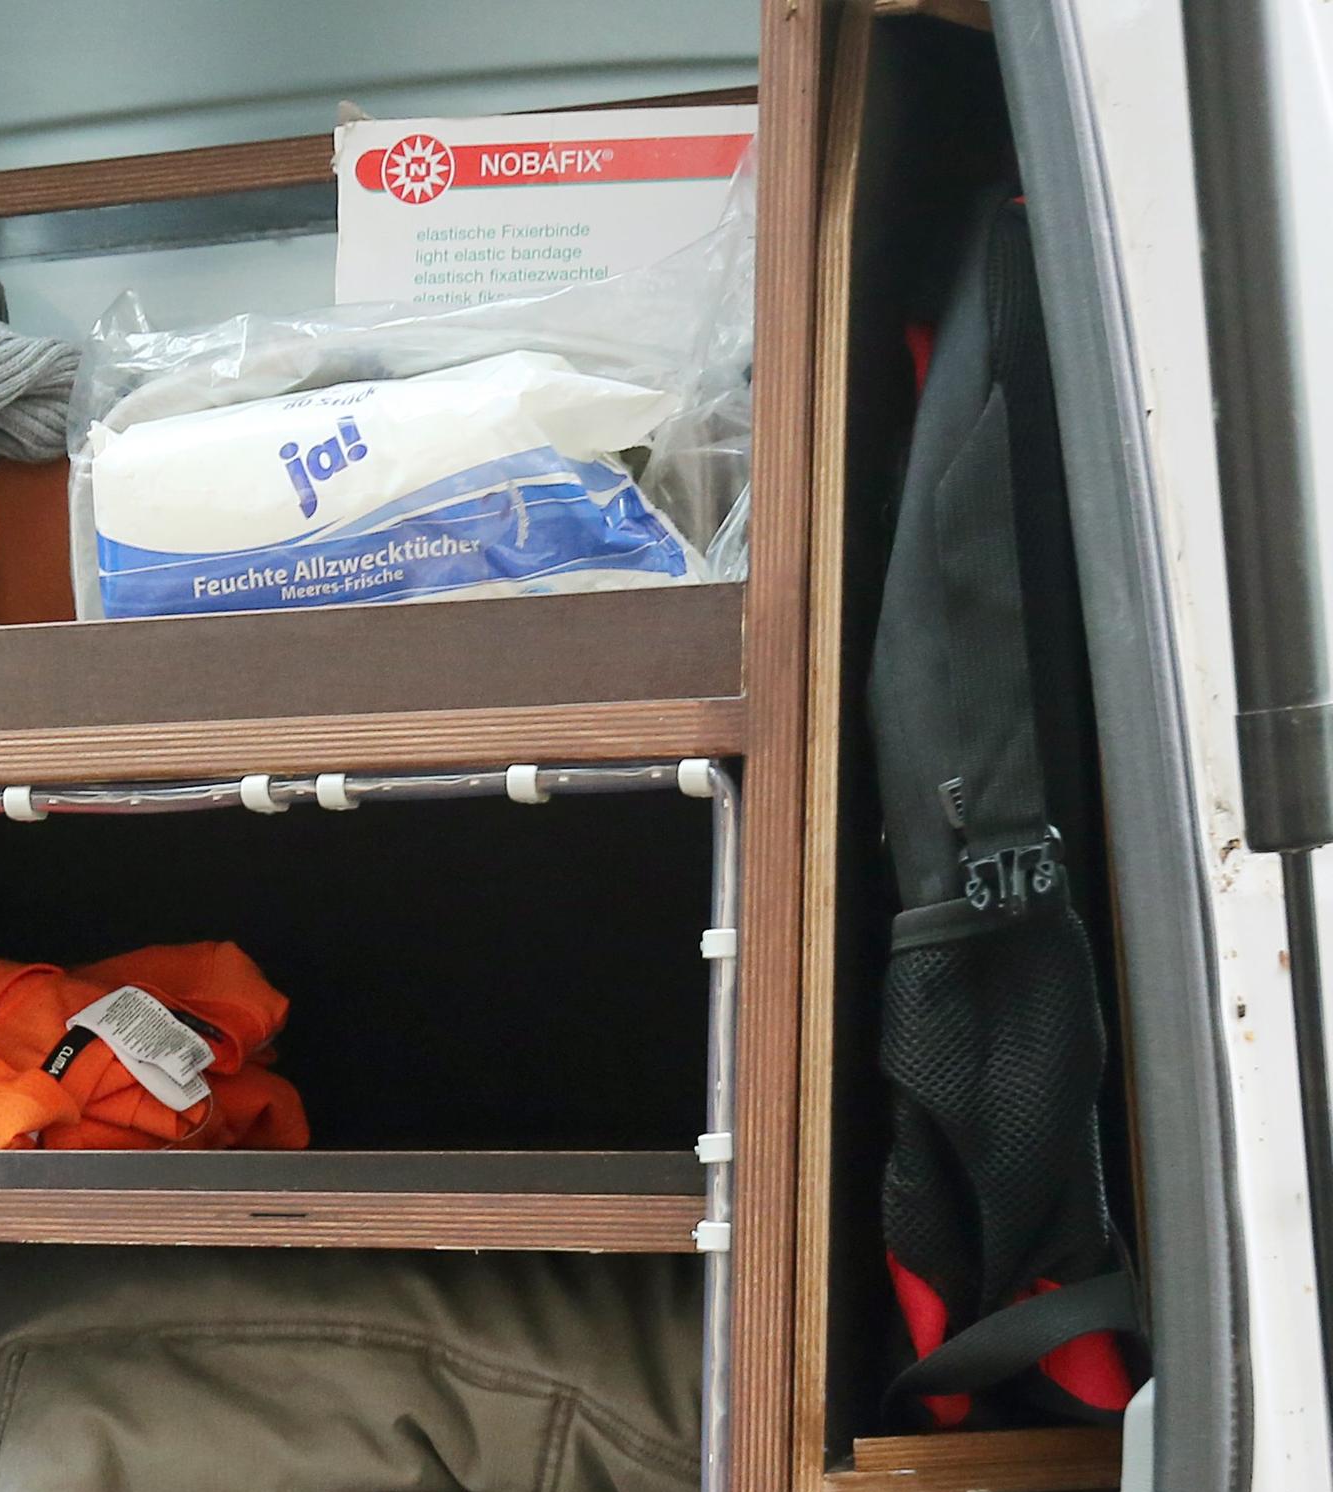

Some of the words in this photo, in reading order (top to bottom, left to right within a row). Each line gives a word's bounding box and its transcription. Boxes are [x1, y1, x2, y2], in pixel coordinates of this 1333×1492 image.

[416, 226, 496, 242] elastische
[501, 223, 590, 240] Fixierbinde
[415, 248, 448, 266] light
[454, 247, 505, 262] elastic
[511, 246, 582, 262] bandage
[414, 269, 483, 285] elastisch
[489, 266, 609, 282] fixatiezwachtel
[278, 416, 368, 520] ja!
[193, 567, 288, 599] Feuchte
[294, 534, 481, 582] Allzwecktücher
[281, 567, 404, 601] Meeres-Frische
